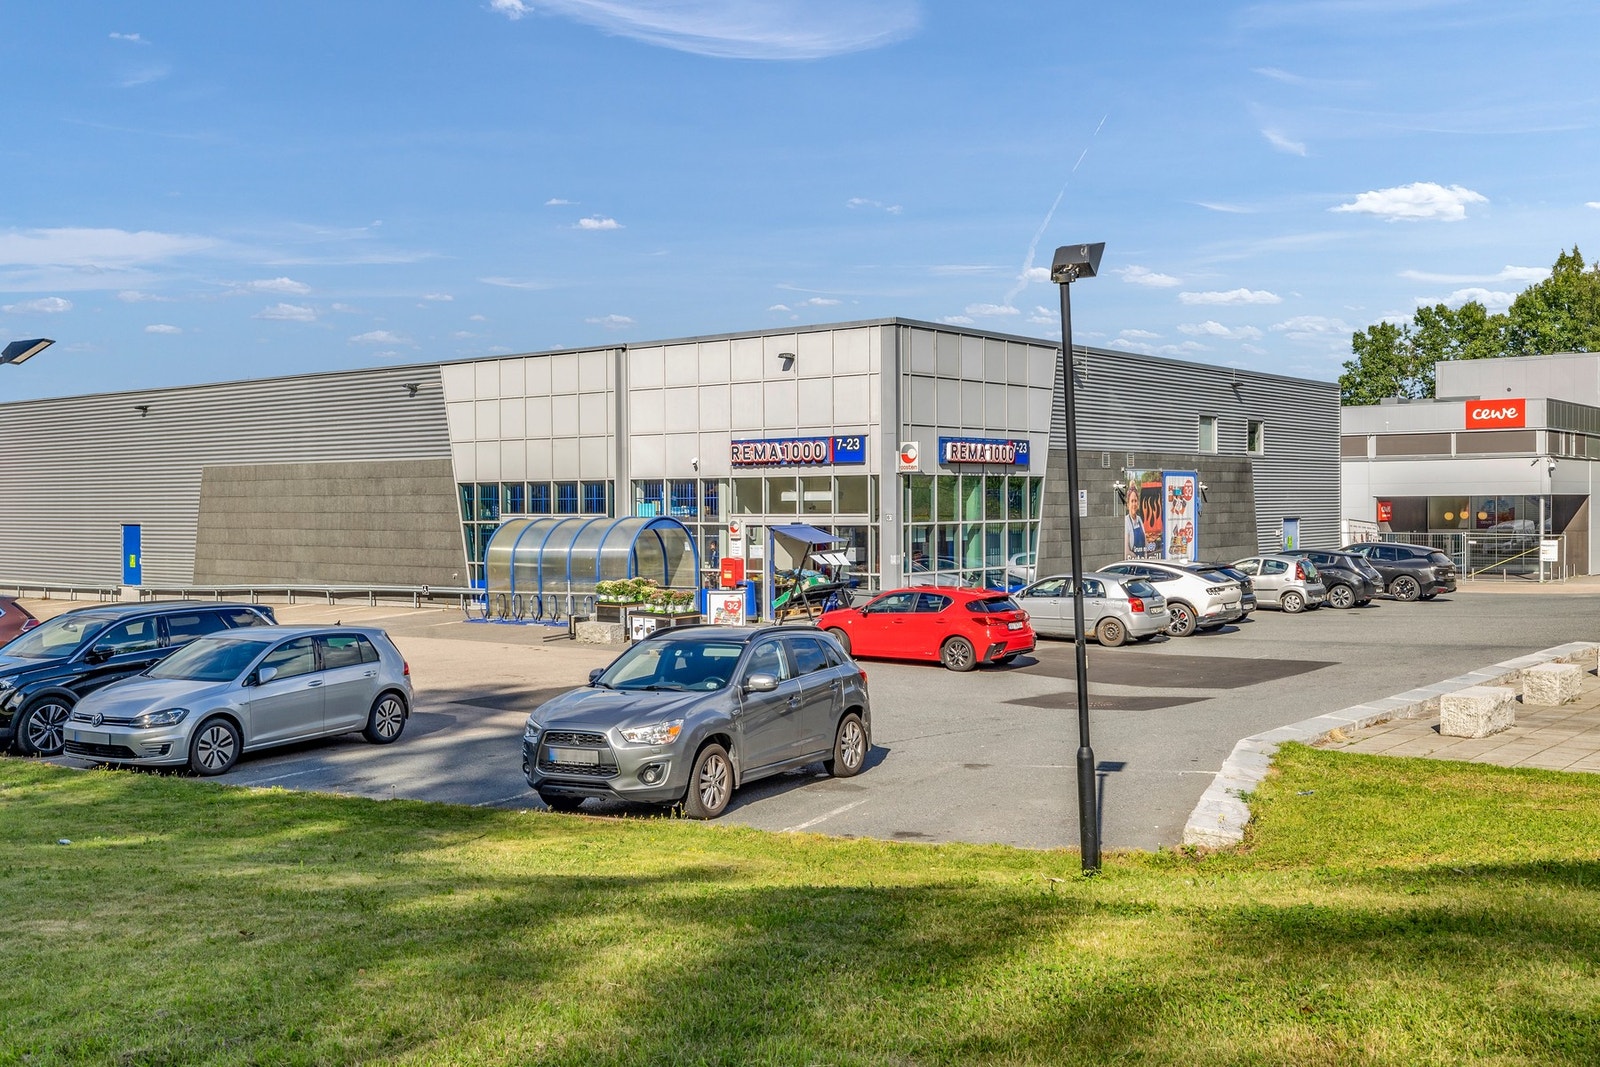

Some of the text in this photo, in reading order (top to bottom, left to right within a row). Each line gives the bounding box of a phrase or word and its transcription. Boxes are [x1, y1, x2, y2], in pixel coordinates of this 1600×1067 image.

[1472, 407, 1519, 420] cewe
[731, 442, 825, 462] REMA 1000
[836, 438, 860, 451] 7-23
[951, 443, 1014, 462] REMA 1000
